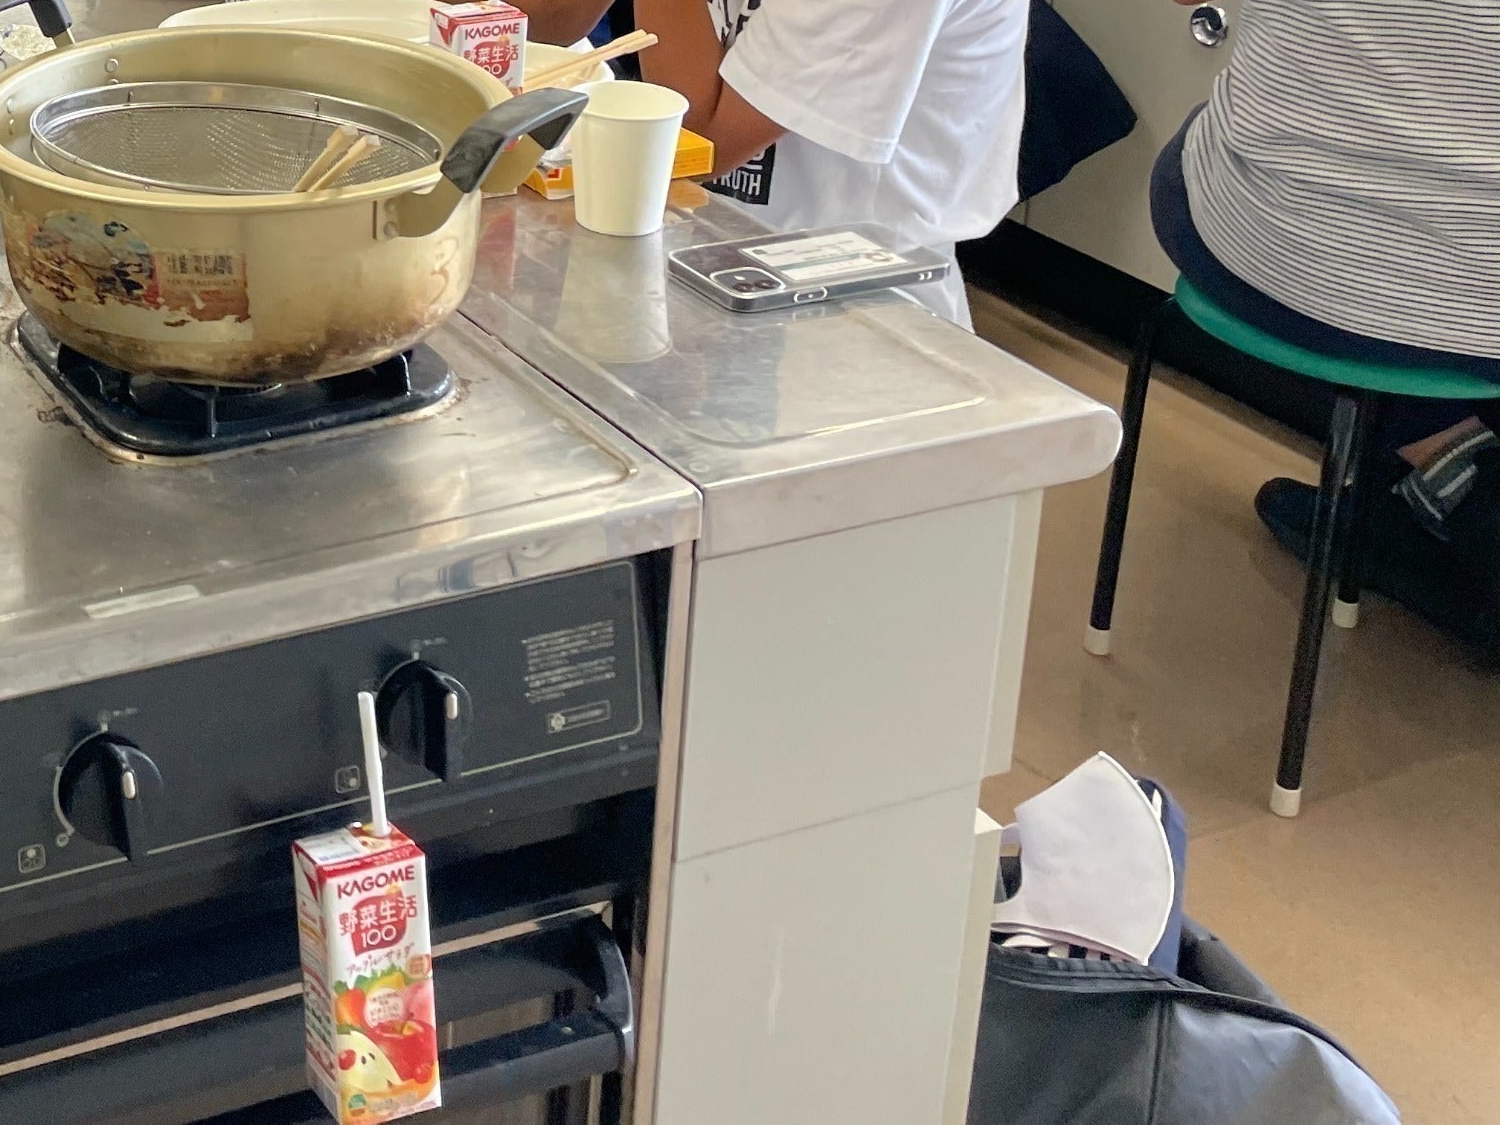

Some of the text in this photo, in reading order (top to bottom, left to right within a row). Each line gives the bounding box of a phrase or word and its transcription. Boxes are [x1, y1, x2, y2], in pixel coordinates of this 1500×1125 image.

[464, 22, 520, 41] KAGOME
[463, 44, 520, 64] 野菜生活
[337, 865, 416, 899] KAGOME
[338, 894, 418, 936] 野菜生活
[361, 926, 397, 948] 100
